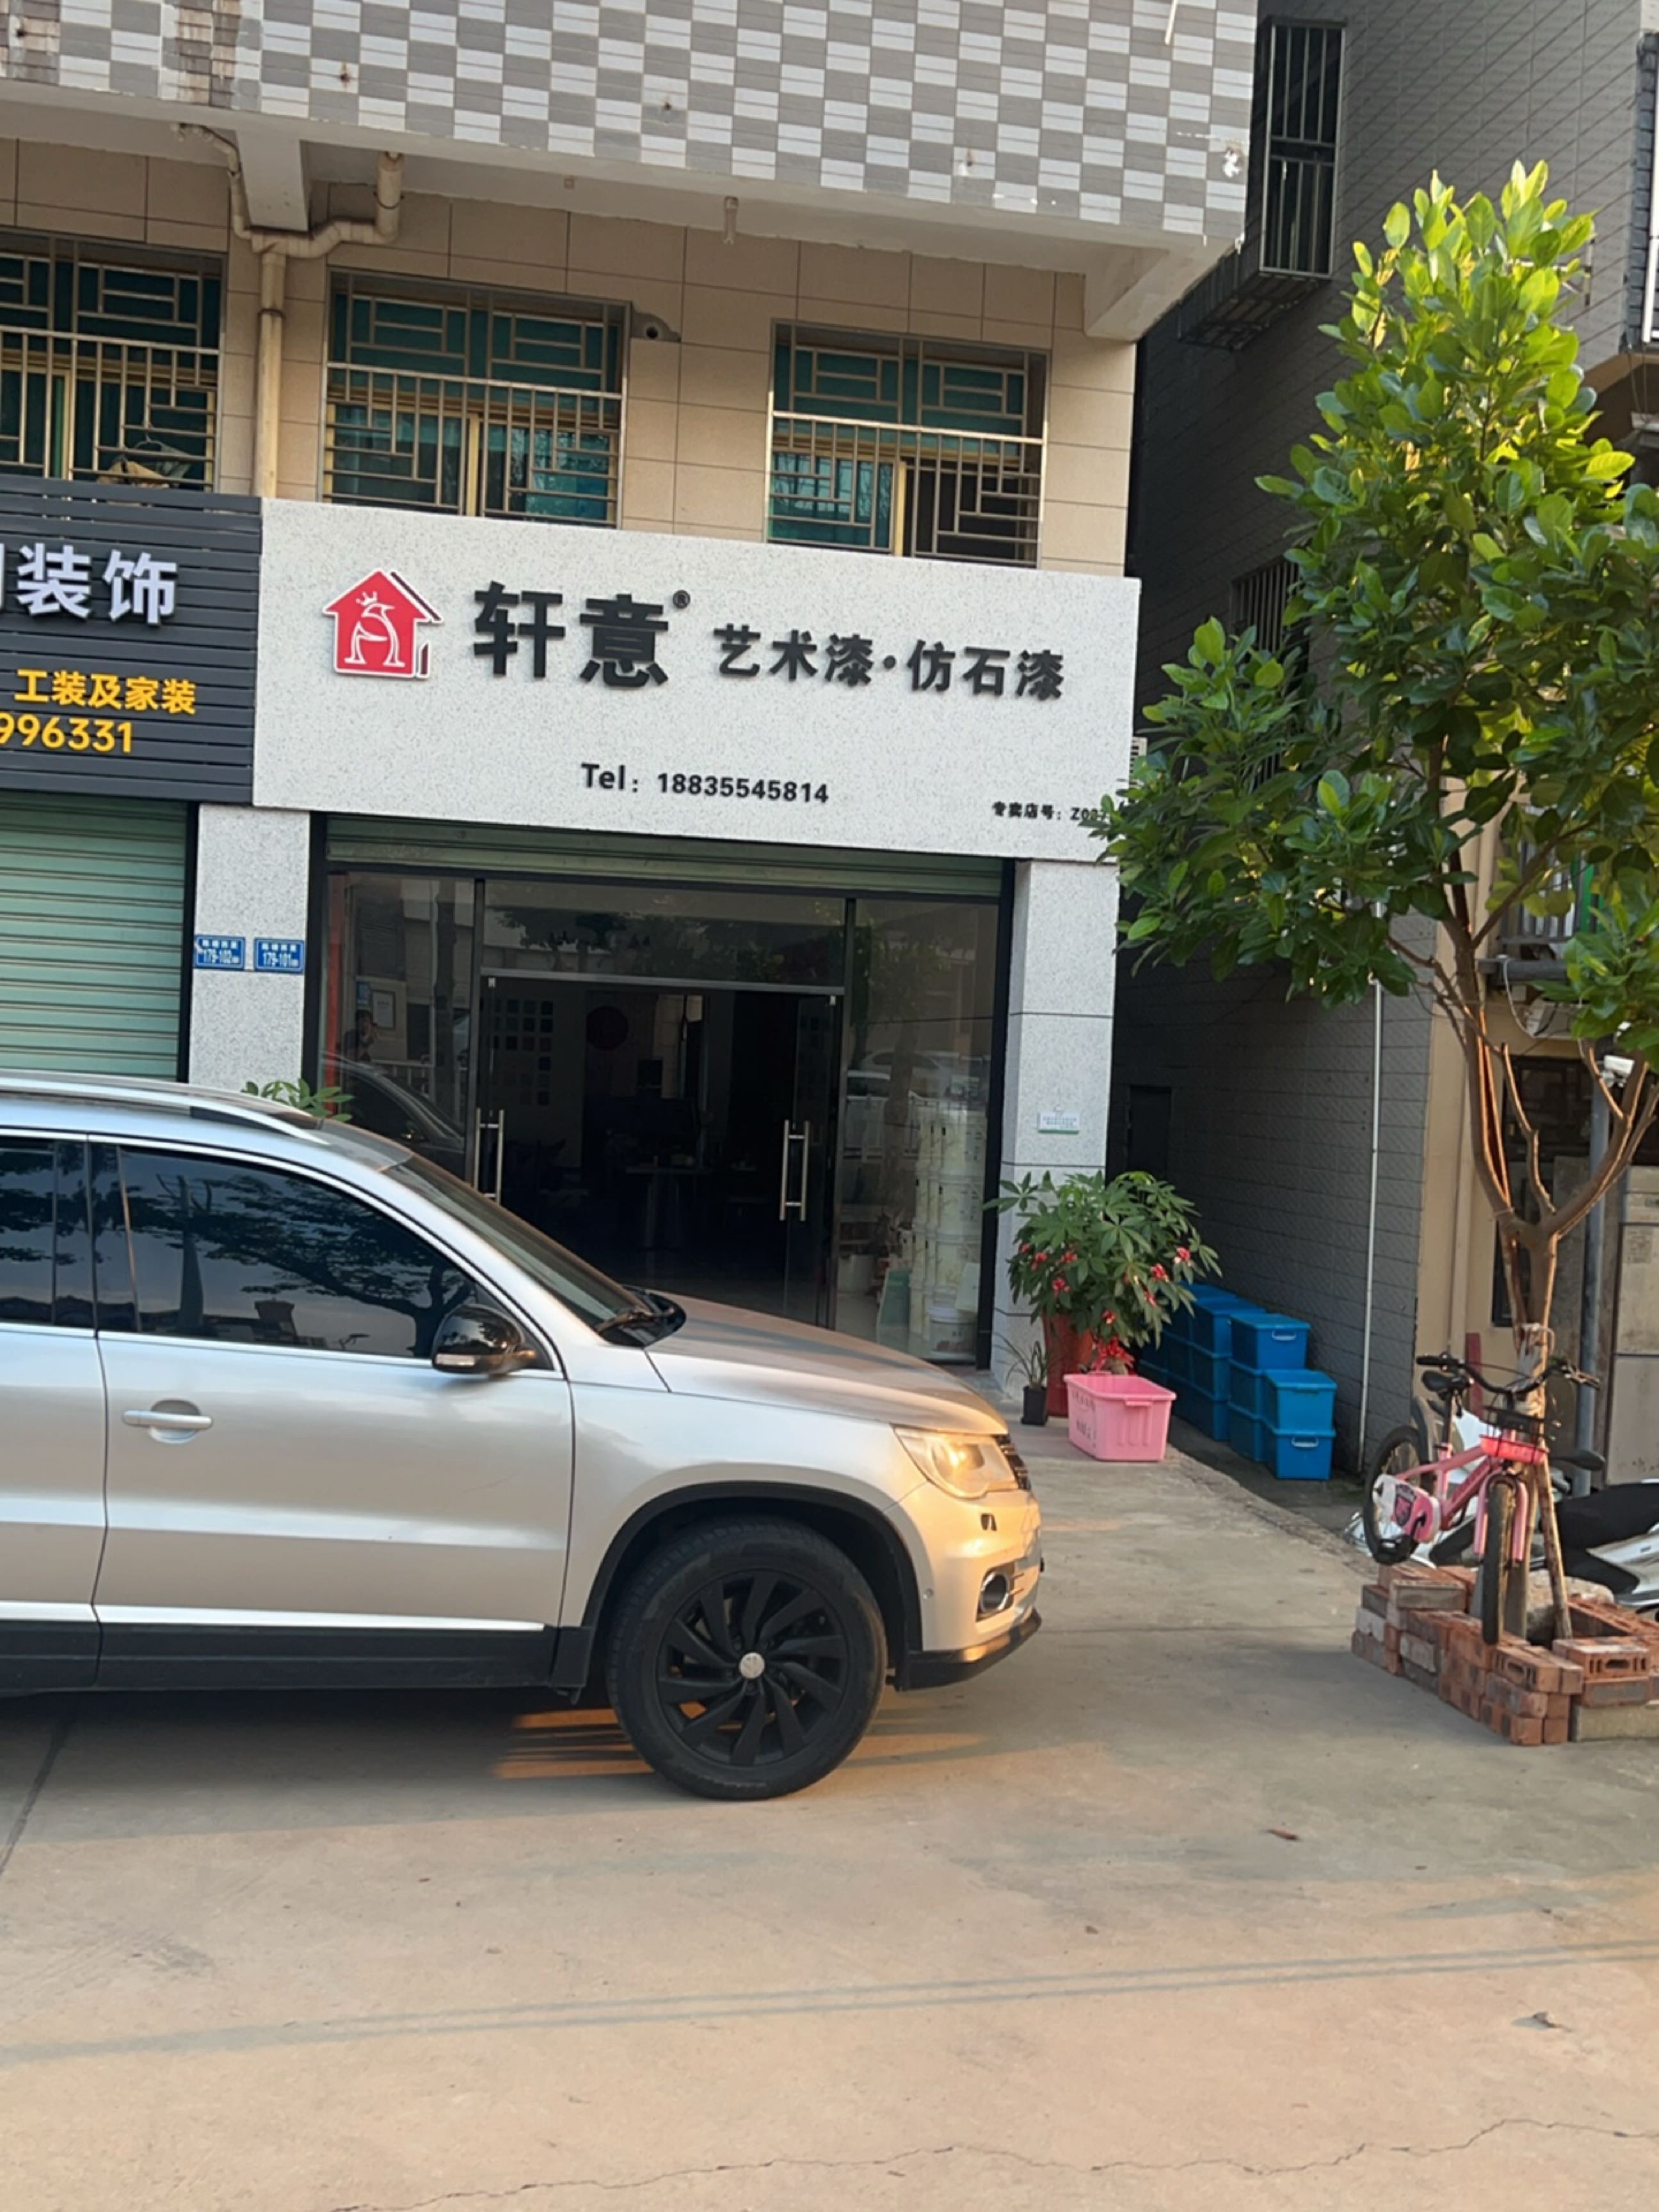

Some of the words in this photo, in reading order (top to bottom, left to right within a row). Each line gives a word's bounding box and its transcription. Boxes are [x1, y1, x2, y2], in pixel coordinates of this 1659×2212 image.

[0, 543, 177, 625] 装饰
[14, 669, 196, 715] 工装及家装
[657, 773, 829, 804] 18835545814
